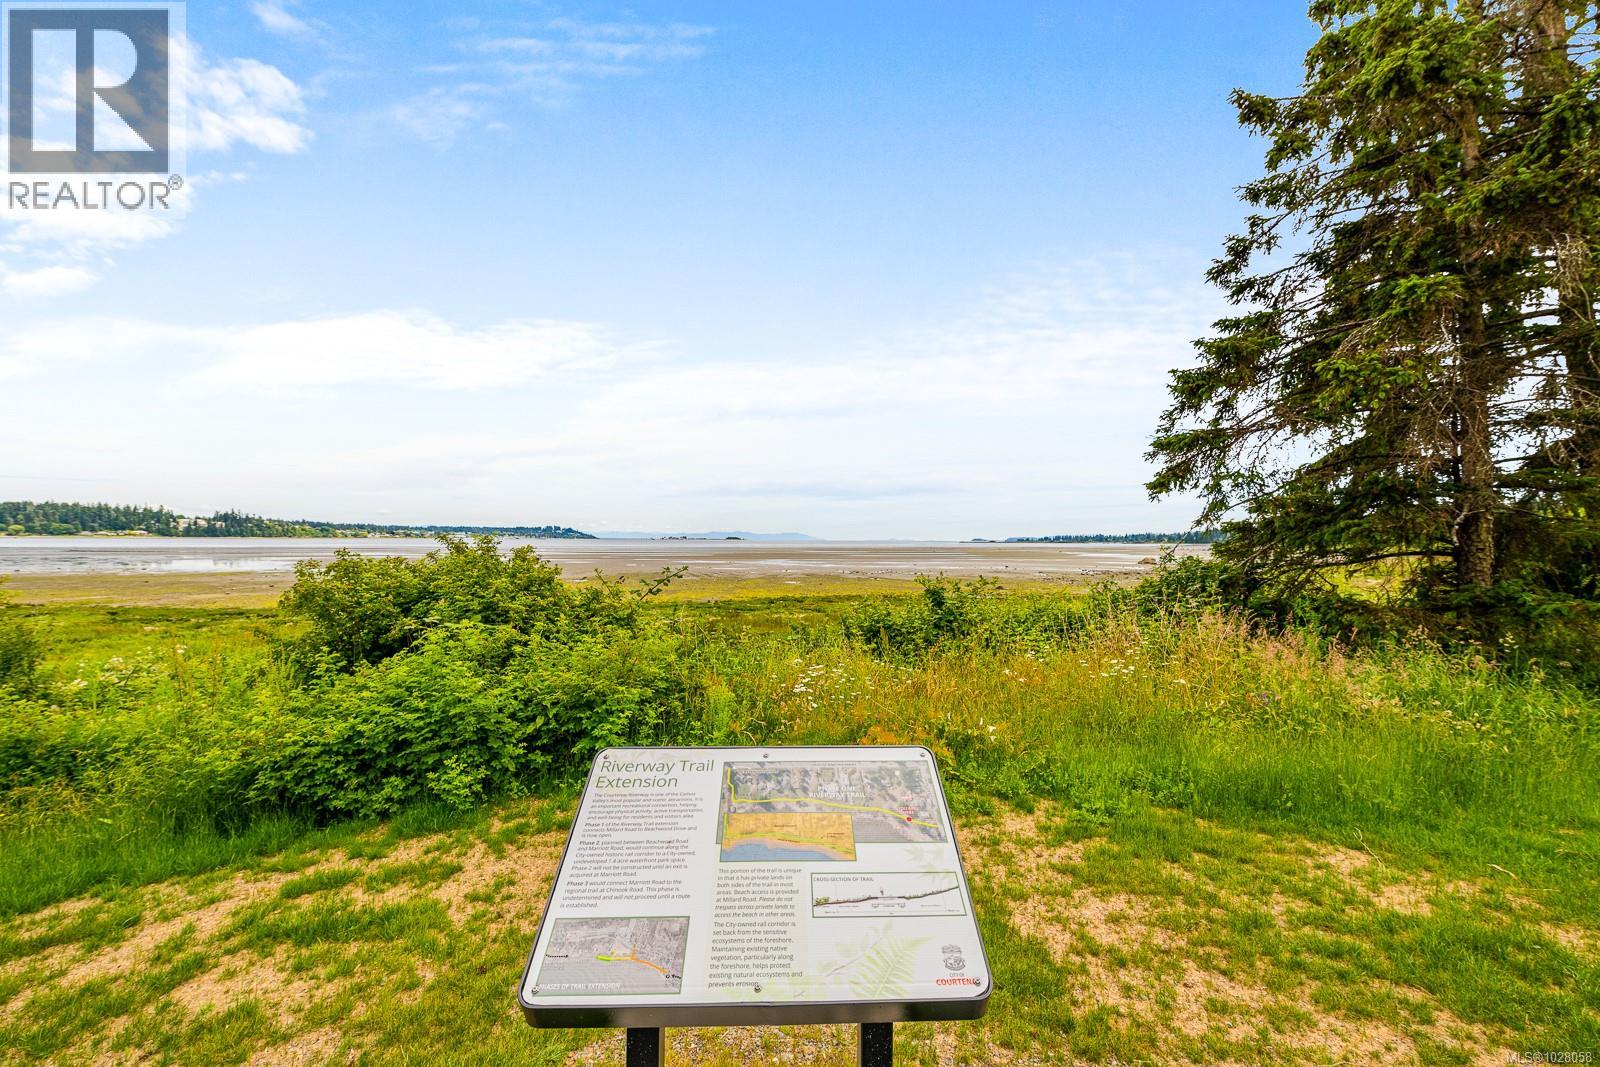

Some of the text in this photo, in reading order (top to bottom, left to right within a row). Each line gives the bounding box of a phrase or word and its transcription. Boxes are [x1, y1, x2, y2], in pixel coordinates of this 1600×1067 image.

[600, 759, 715, 776] Riverway Trail
[595, 776, 678, 788] Extension
